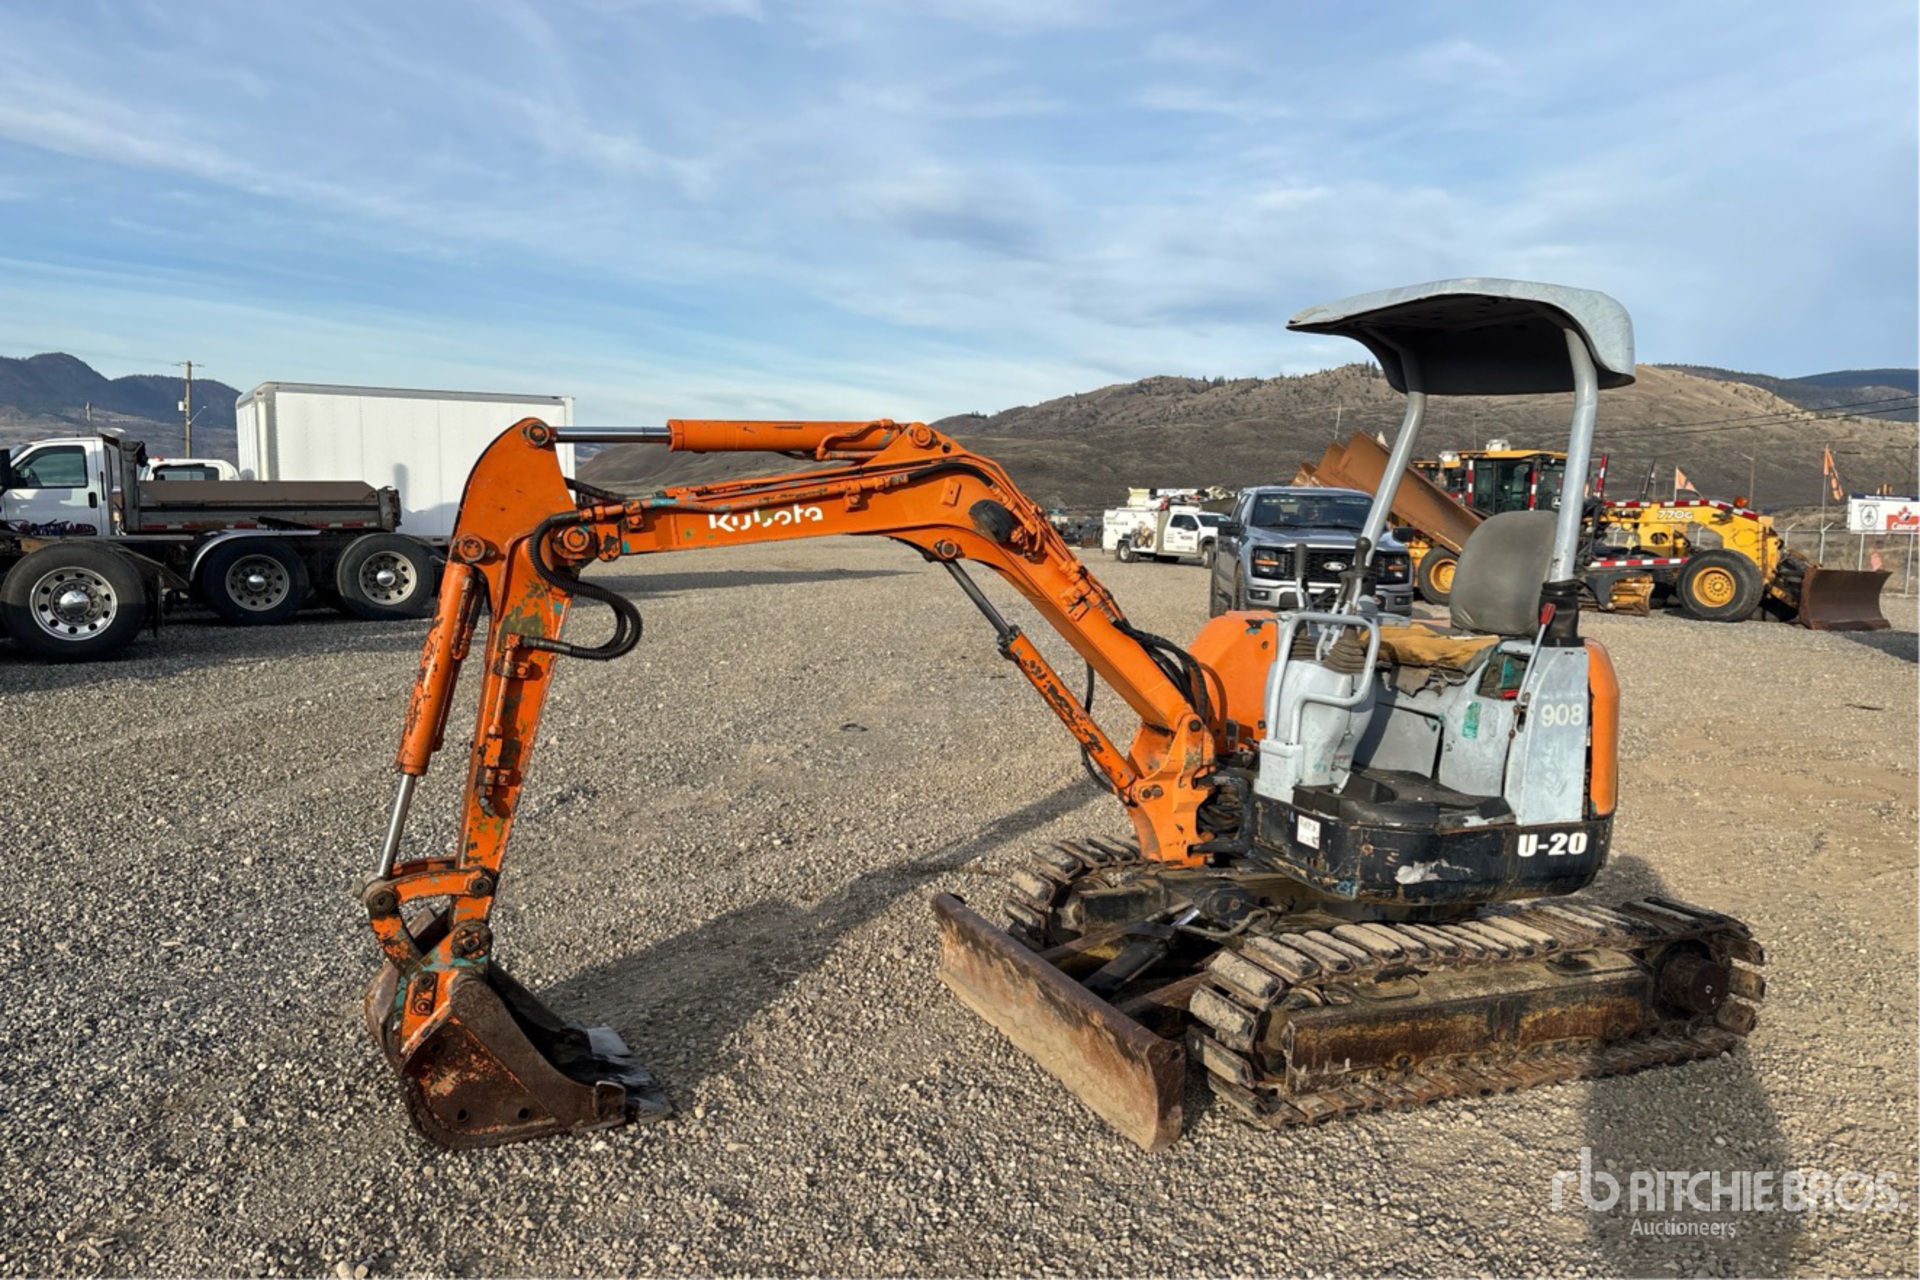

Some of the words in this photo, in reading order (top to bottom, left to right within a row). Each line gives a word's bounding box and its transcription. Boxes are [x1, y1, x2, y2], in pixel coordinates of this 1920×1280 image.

[708, 503, 823, 532] Kubota
[1541, 703, 1584, 727] 908
[1517, 832, 1588, 858] U-20
